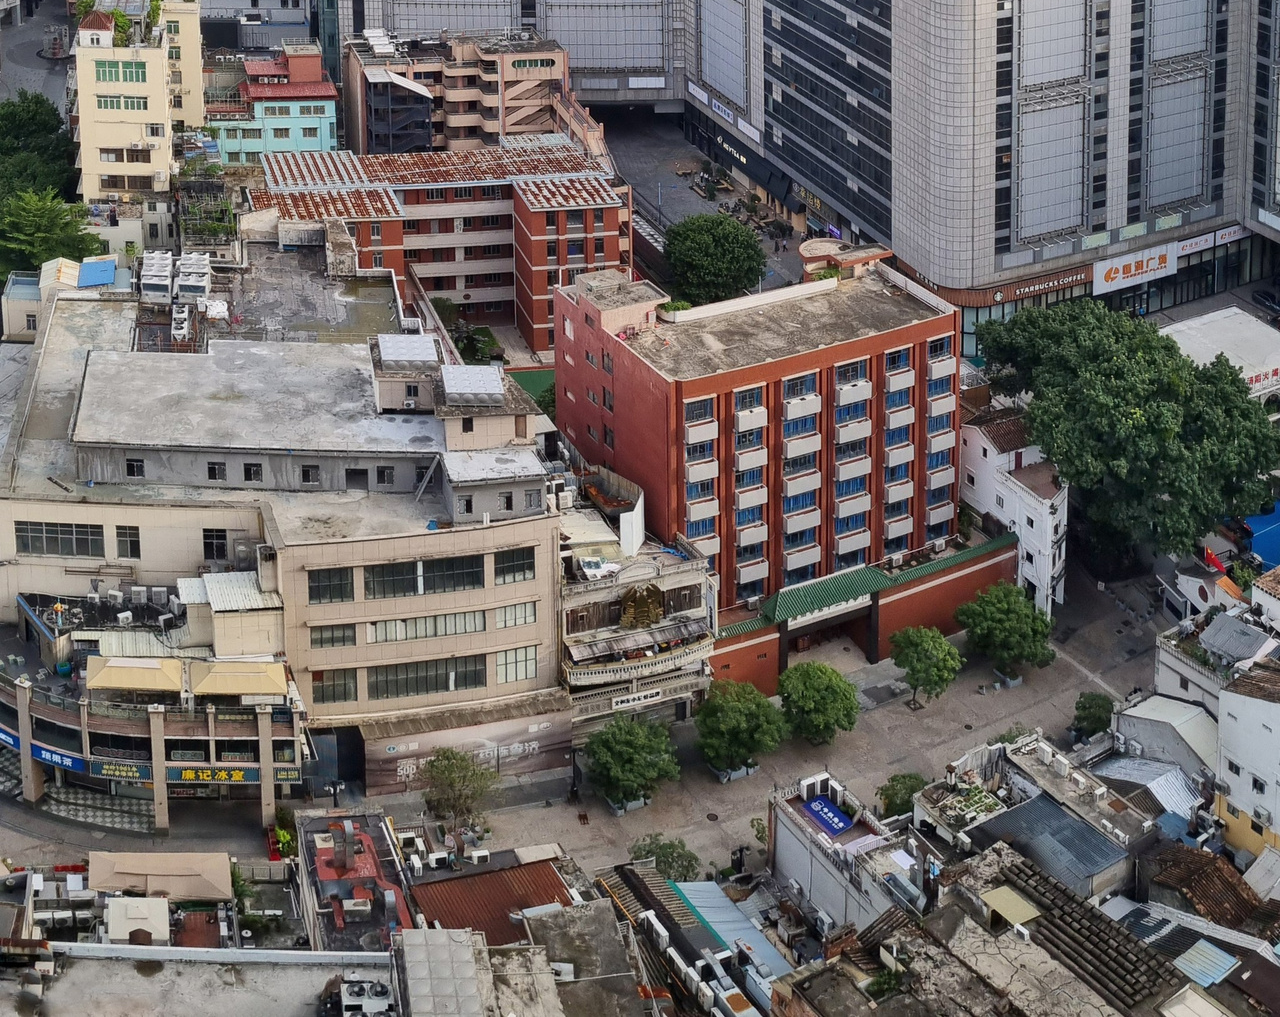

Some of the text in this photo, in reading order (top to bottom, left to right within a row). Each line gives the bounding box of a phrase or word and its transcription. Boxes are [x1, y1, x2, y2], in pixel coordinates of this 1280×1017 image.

[1015, 273, 1086, 296] STARBUCKS COFFEE
[181, 769, 245, 781] 廉记冰室
[397, 765, 417, 775] 500
